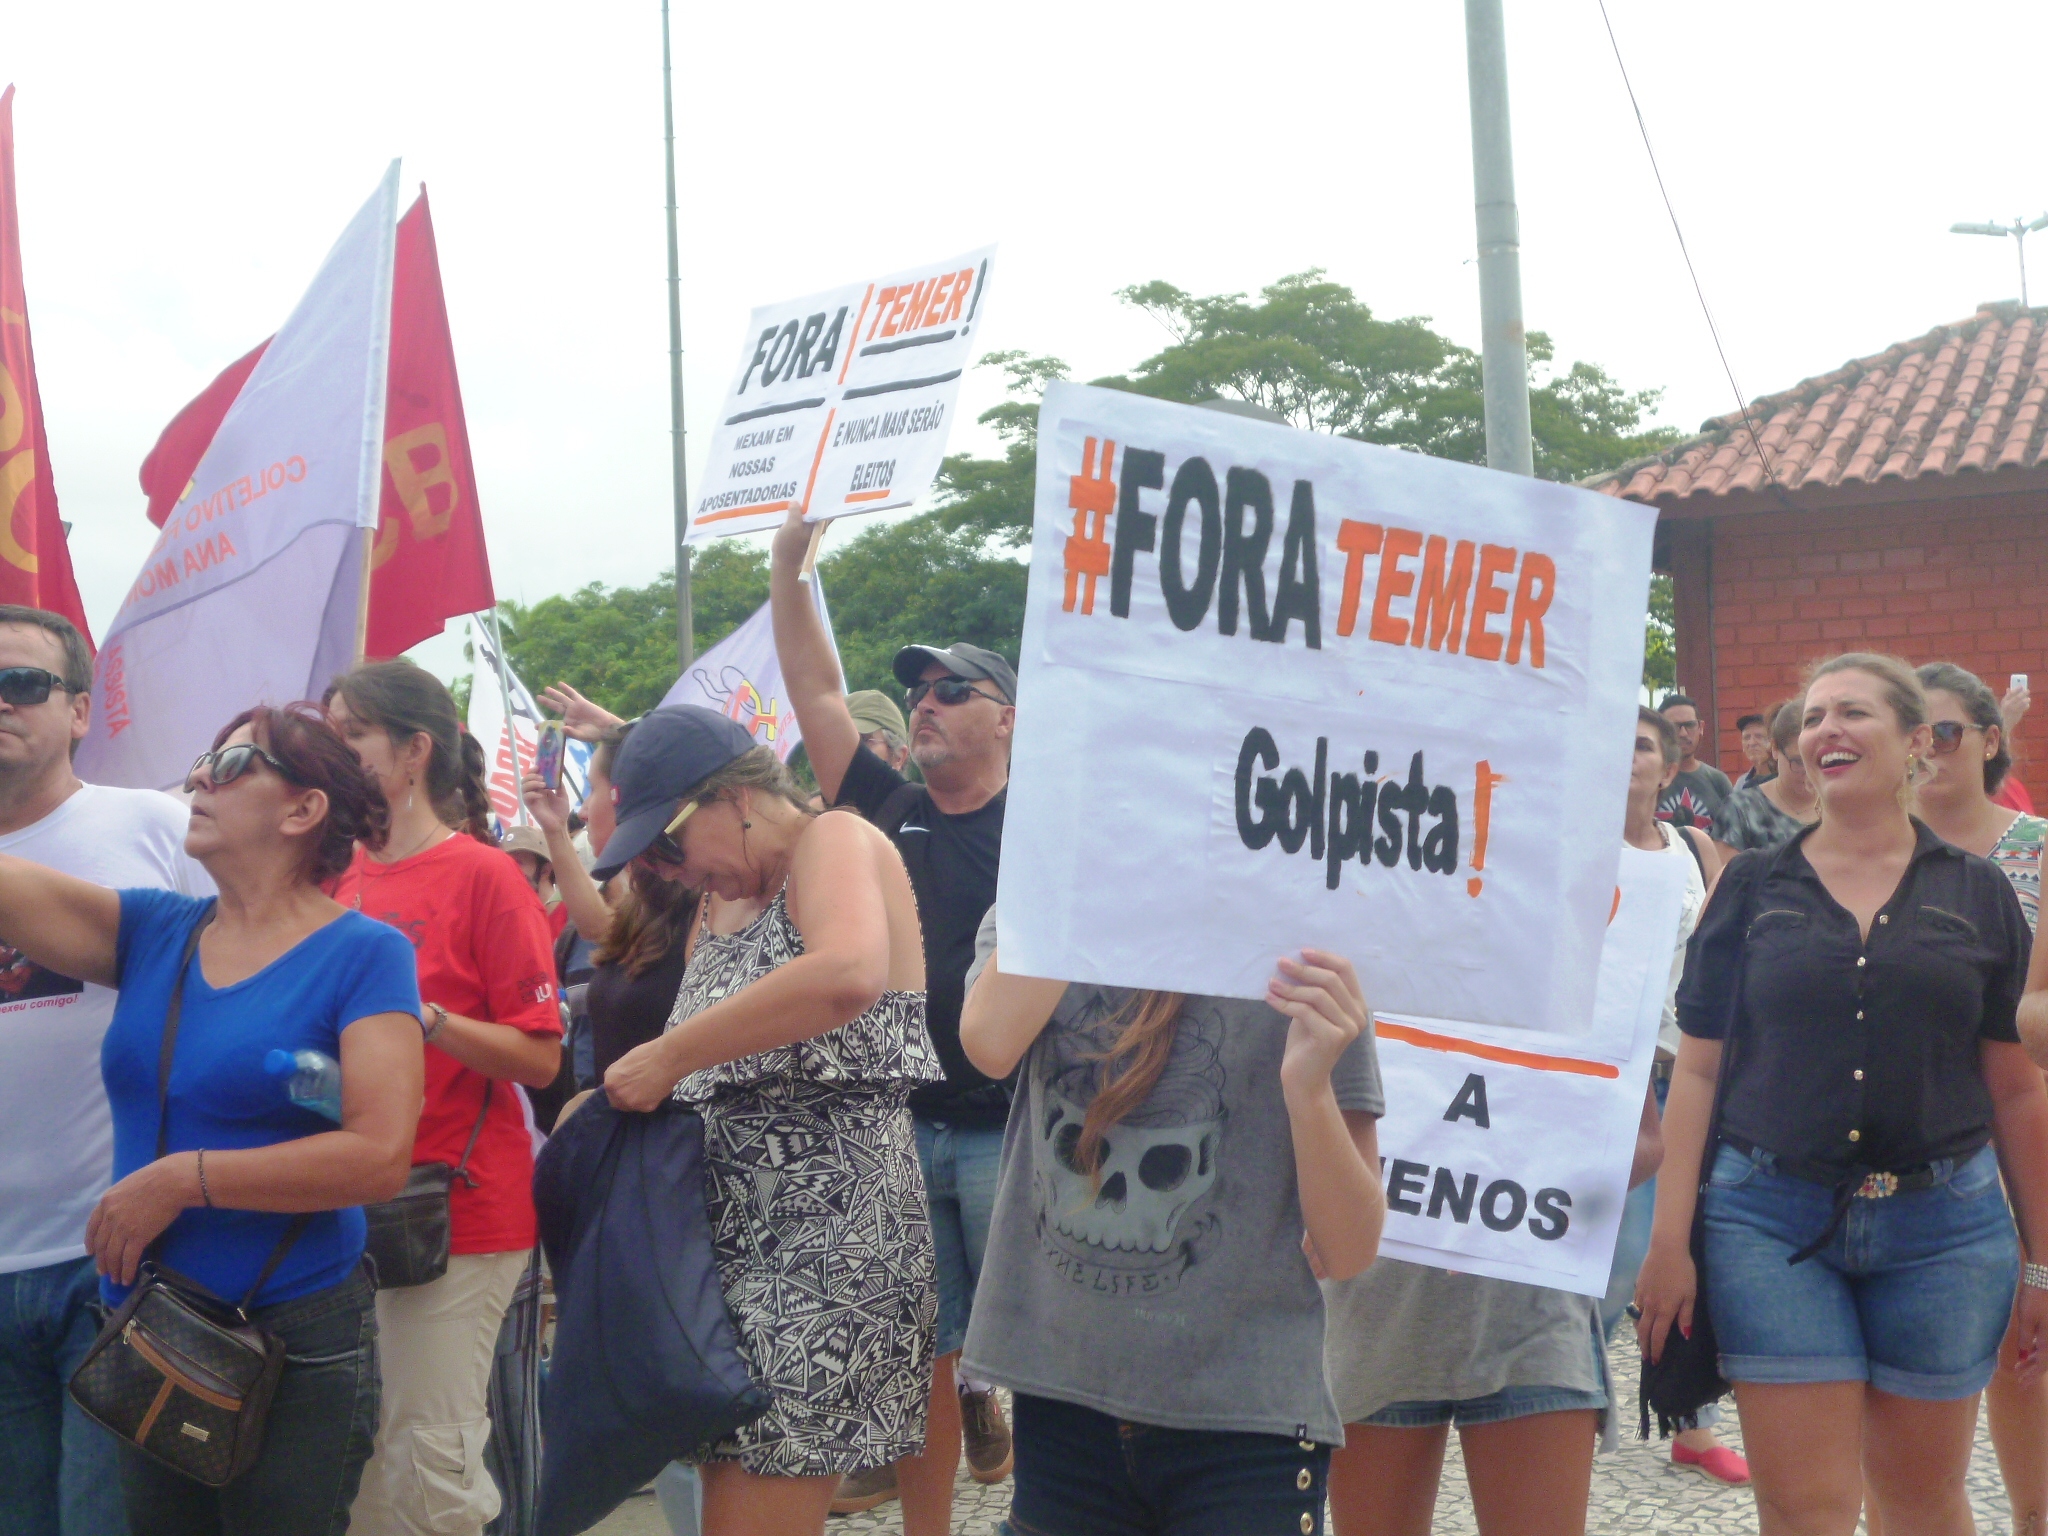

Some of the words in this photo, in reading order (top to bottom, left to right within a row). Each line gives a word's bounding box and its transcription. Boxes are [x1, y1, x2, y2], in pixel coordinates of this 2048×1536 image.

[737, 306, 848, 395] FORA
[866, 257, 988, 342] TEMER!
[733, 429, 775, 450] MEXAM
[775, 425, 795, 443] EM
[832, 422, 844, 448] E
[842, 414, 880, 446] NUNCA
[878, 407, 909, 439] MAIS
[728, 456, 776, 479] NOSSAS
[850, 459, 896, 491] ELEITOS
[698, 481, 797, 513] APOSENTADORIAS
[1062, 436, 1322, 650] #FORA
[1336, 518, 1556, 669] TEMER
[1234, 726, 1492, 898] Golpista!
[0, 1003, 26, 1015] exeu
[29, 993, 79, 1011] comigo!
[1443, 1073, 1490, 1129] A
[1380, 1156, 1573, 1241] ENOS
